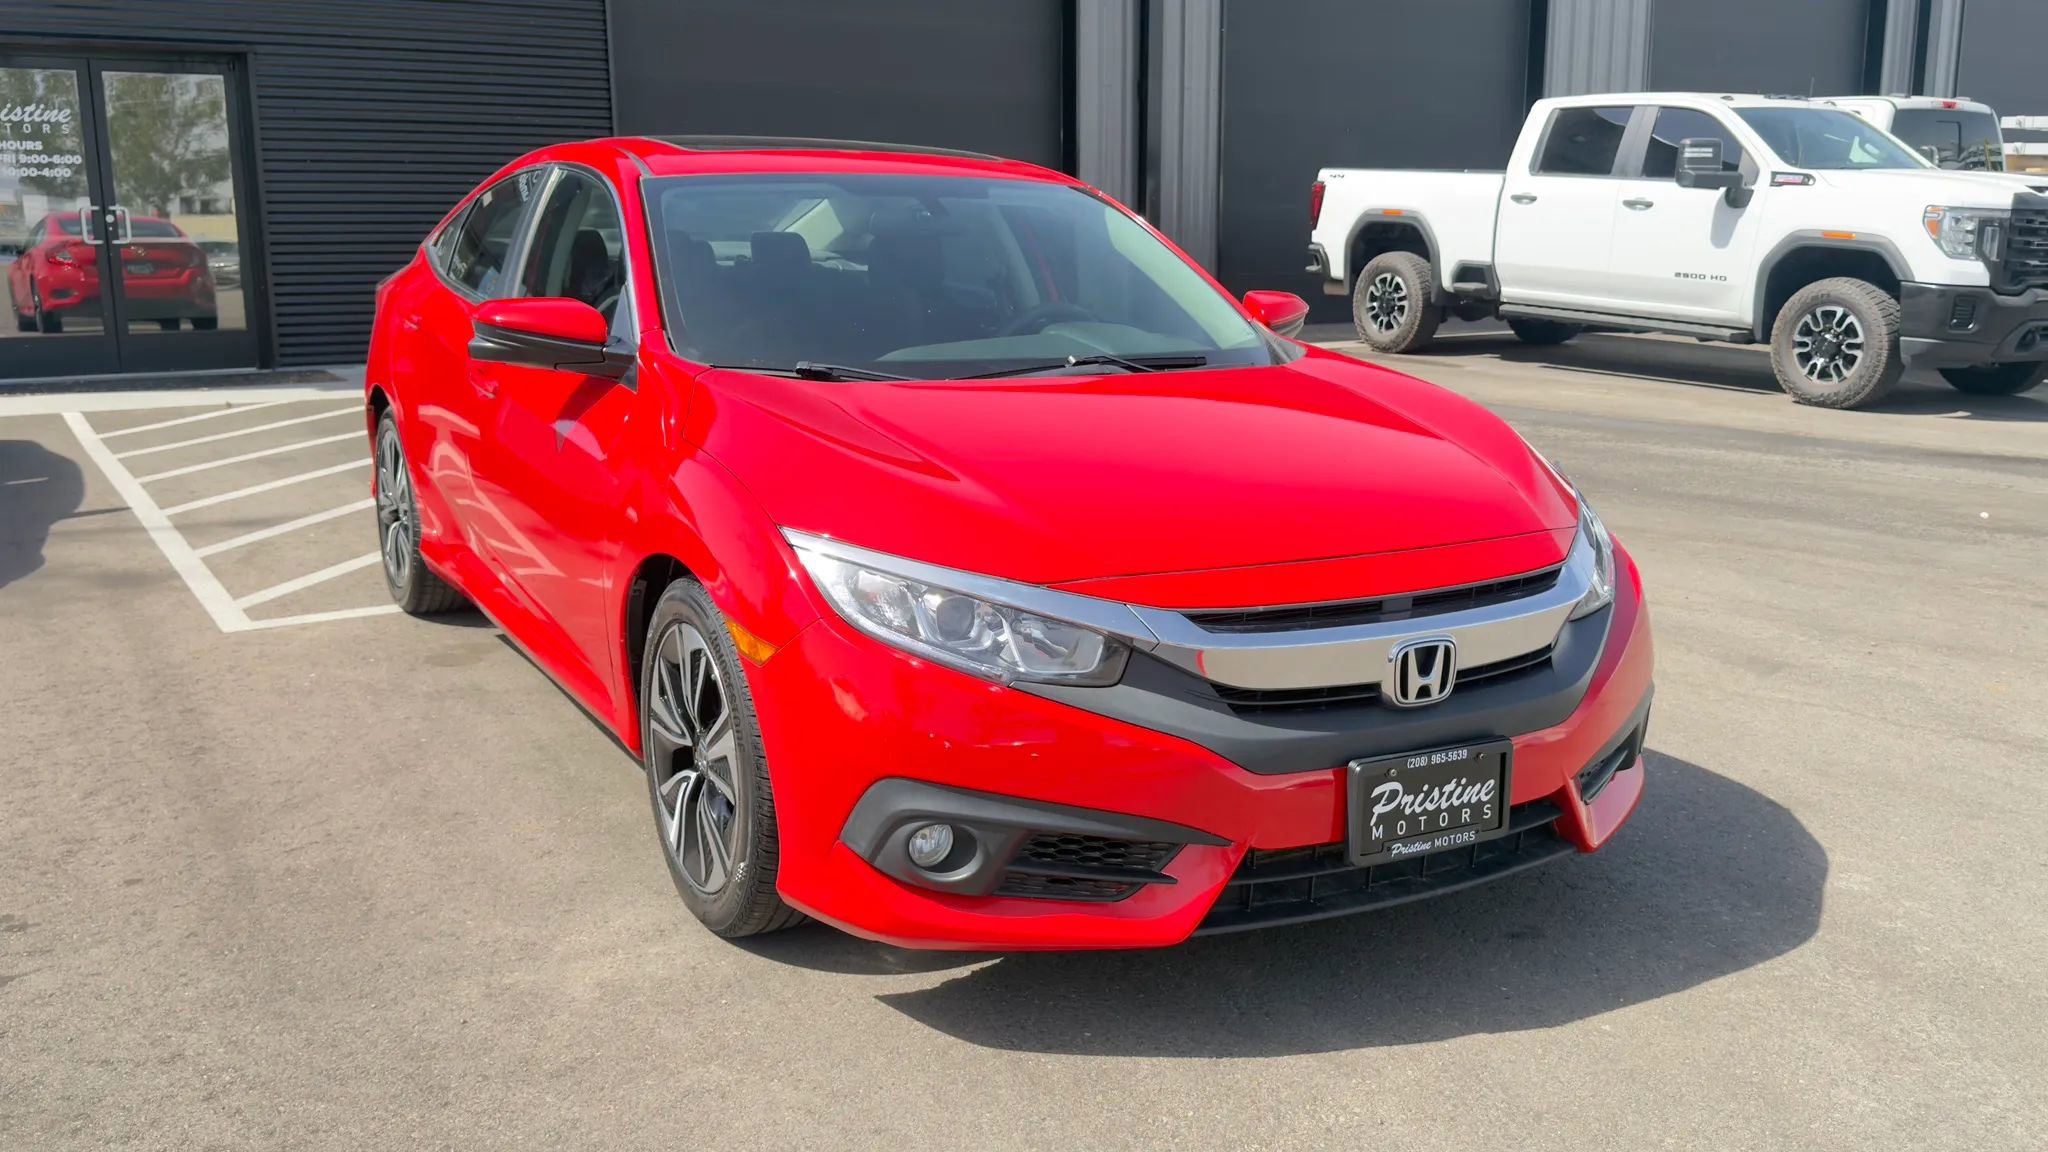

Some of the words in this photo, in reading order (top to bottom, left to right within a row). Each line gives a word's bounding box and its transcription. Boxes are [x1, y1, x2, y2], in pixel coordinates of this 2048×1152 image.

[0, 140, 43, 150] HOURS
[18, 154, 82, 164] 9:00-6:00
[1407, 756, 1428, 769] (208)
[1430, 749, 1468, 765] 965-5639
[1370, 777, 1495, 827] Pristine
[1371, 803, 1492, 841] MOTORS
[1391, 841, 1432, 858] Pristine
[1434, 830, 1476, 848] MOTORS
